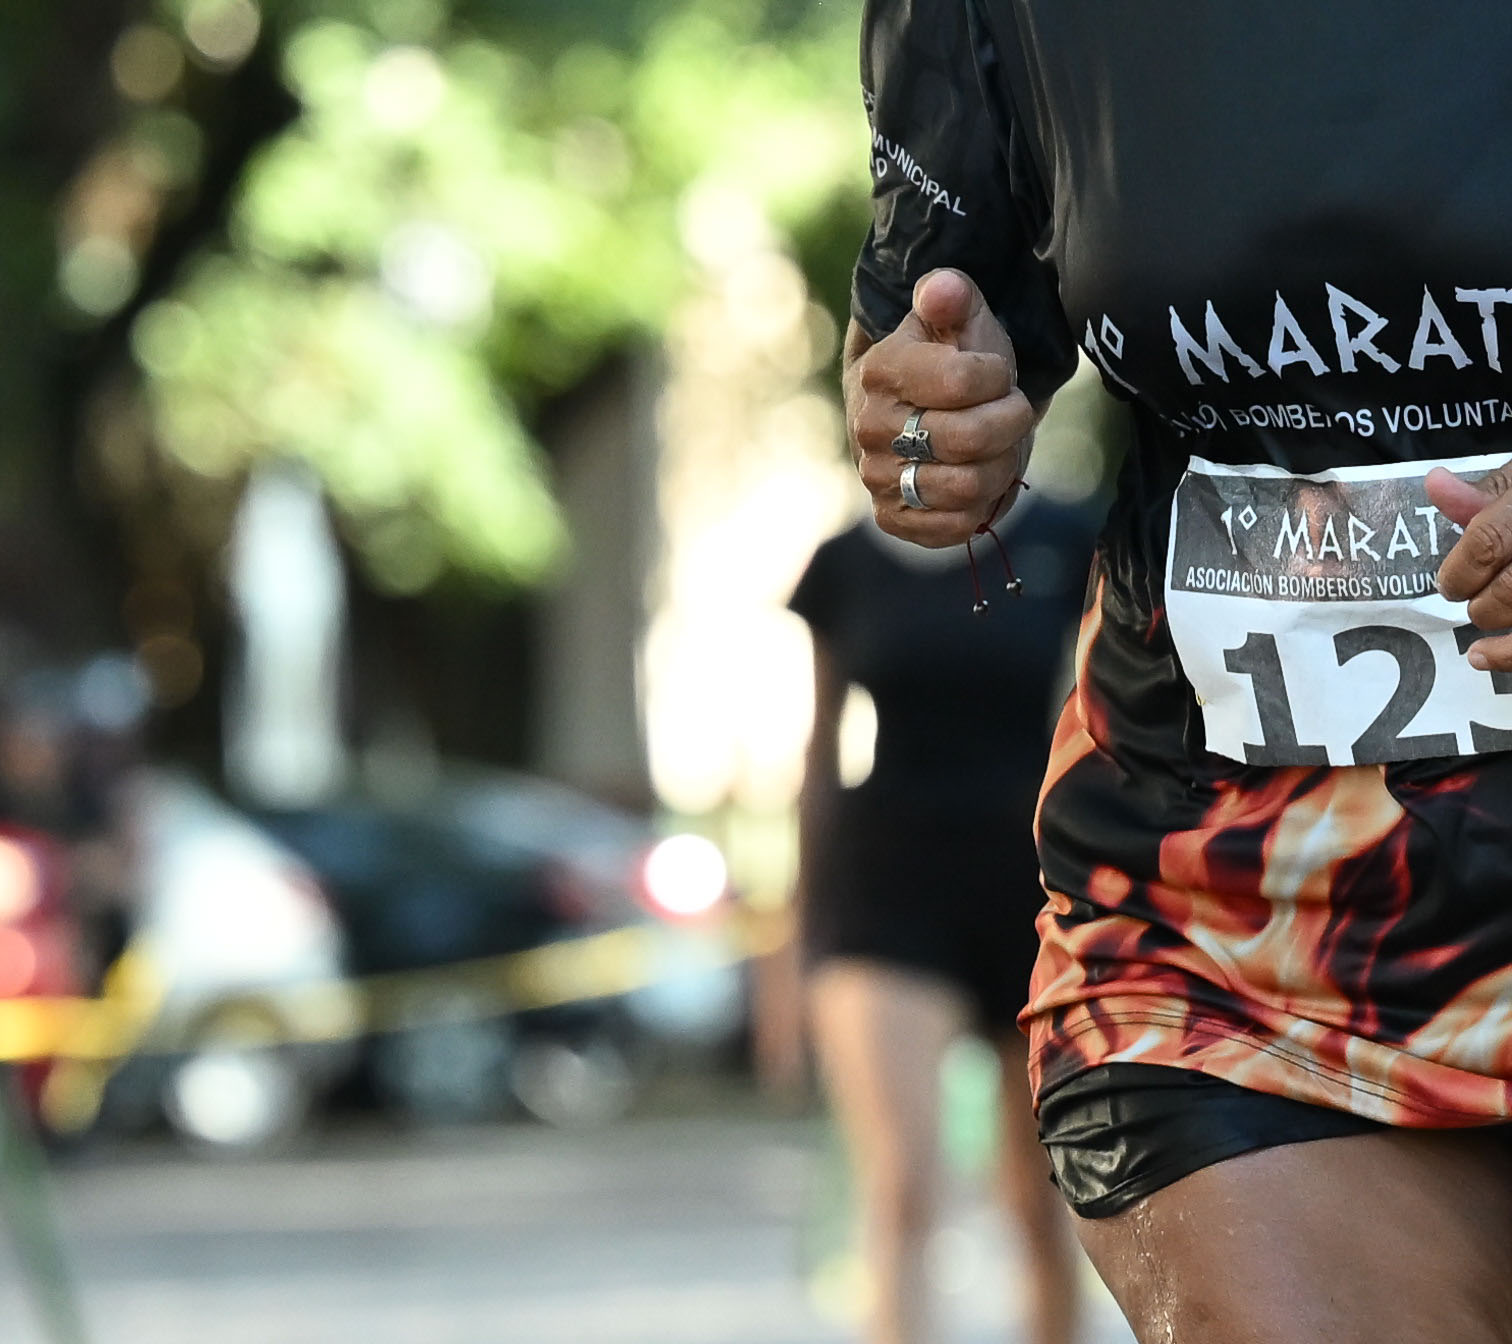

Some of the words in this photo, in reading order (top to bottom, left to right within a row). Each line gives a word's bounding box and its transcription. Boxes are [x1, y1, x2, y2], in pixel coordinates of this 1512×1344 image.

[871, 126, 967, 216] MUNICIPAL
[1229, 404, 1375, 437] BOMBEOS
[1273, 505, 1463, 562] MARAT
[1186, 566, 1273, 596] ASOCIACIÓN
[1279, 575, 1373, 599] BOMBEROS
[1377, 571, 1440, 596] VOLUN
